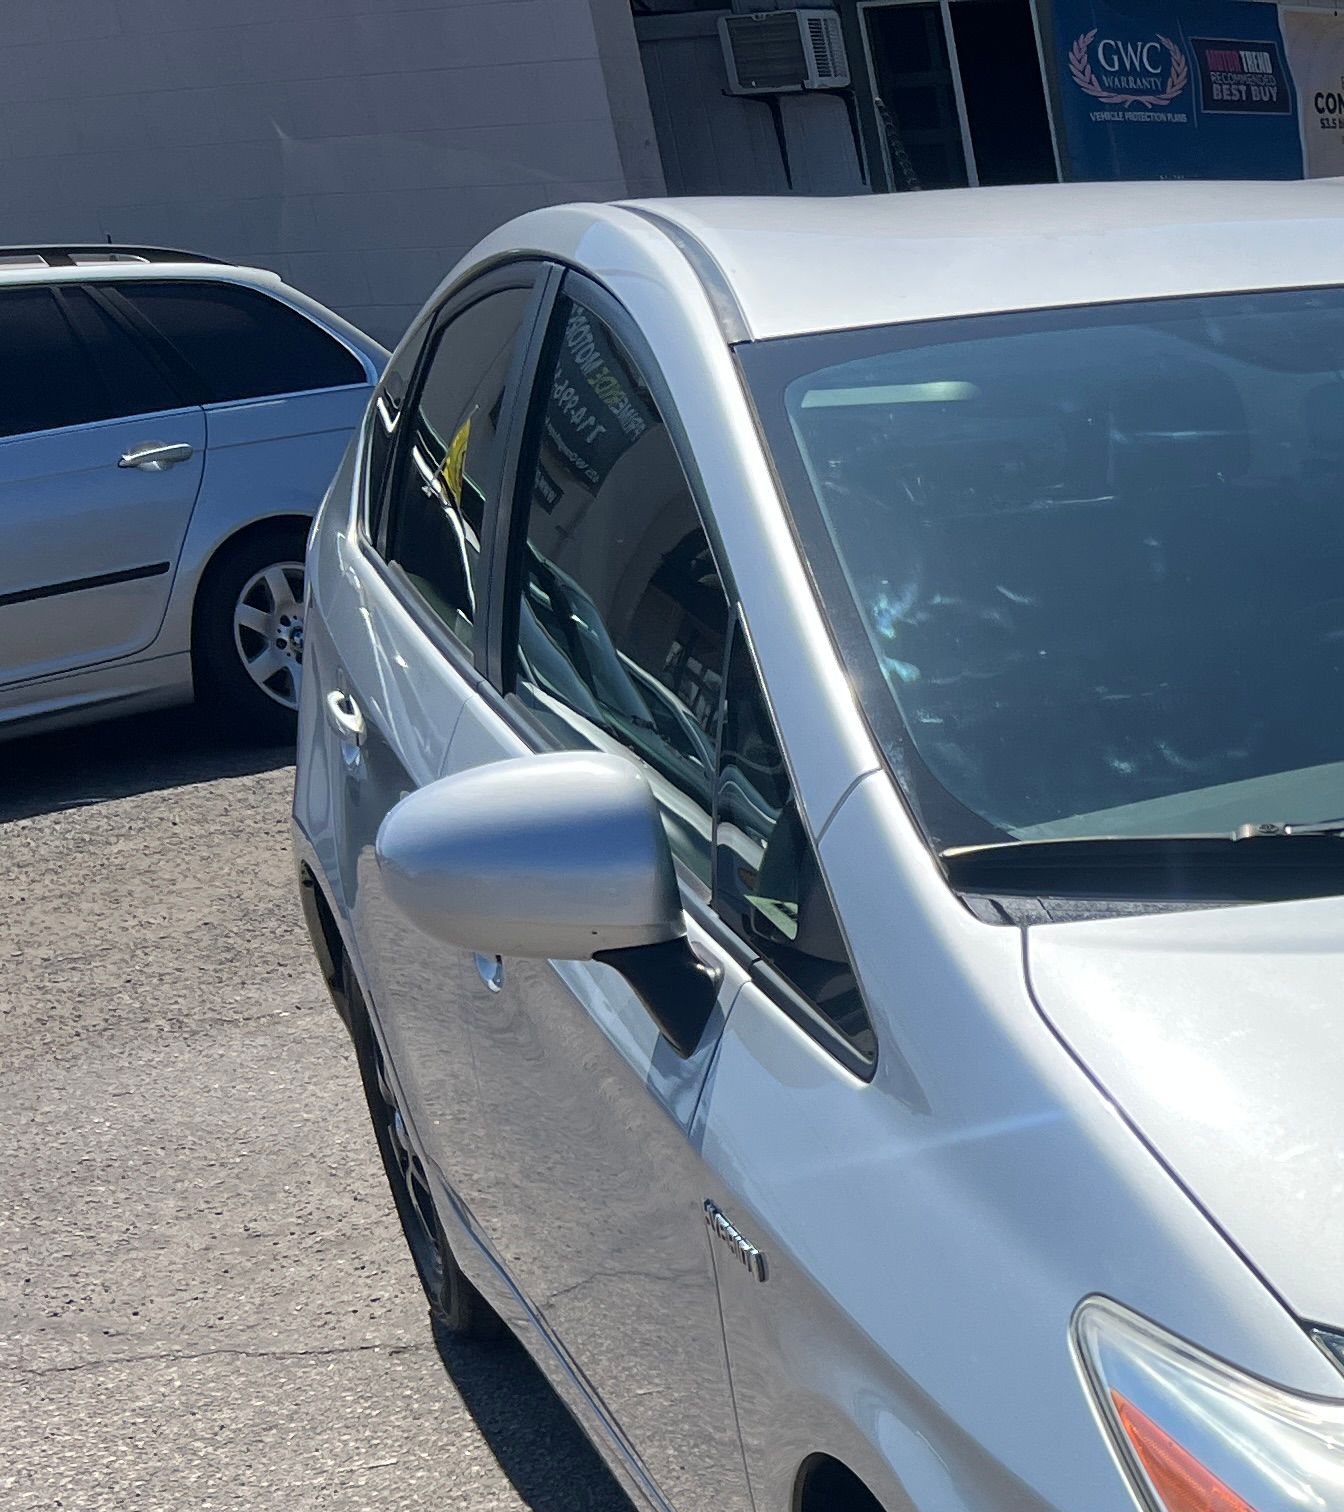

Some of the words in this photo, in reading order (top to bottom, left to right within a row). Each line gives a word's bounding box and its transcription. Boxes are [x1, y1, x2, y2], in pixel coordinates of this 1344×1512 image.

[1097, 39, 1162, 74] GWC
[1240, 51, 1272, 74] TREND
[1102, 75, 1163, 91] WARRANTY
[1213, 84, 1247, 101] BEST
[1250, 86, 1278, 102] BUY
